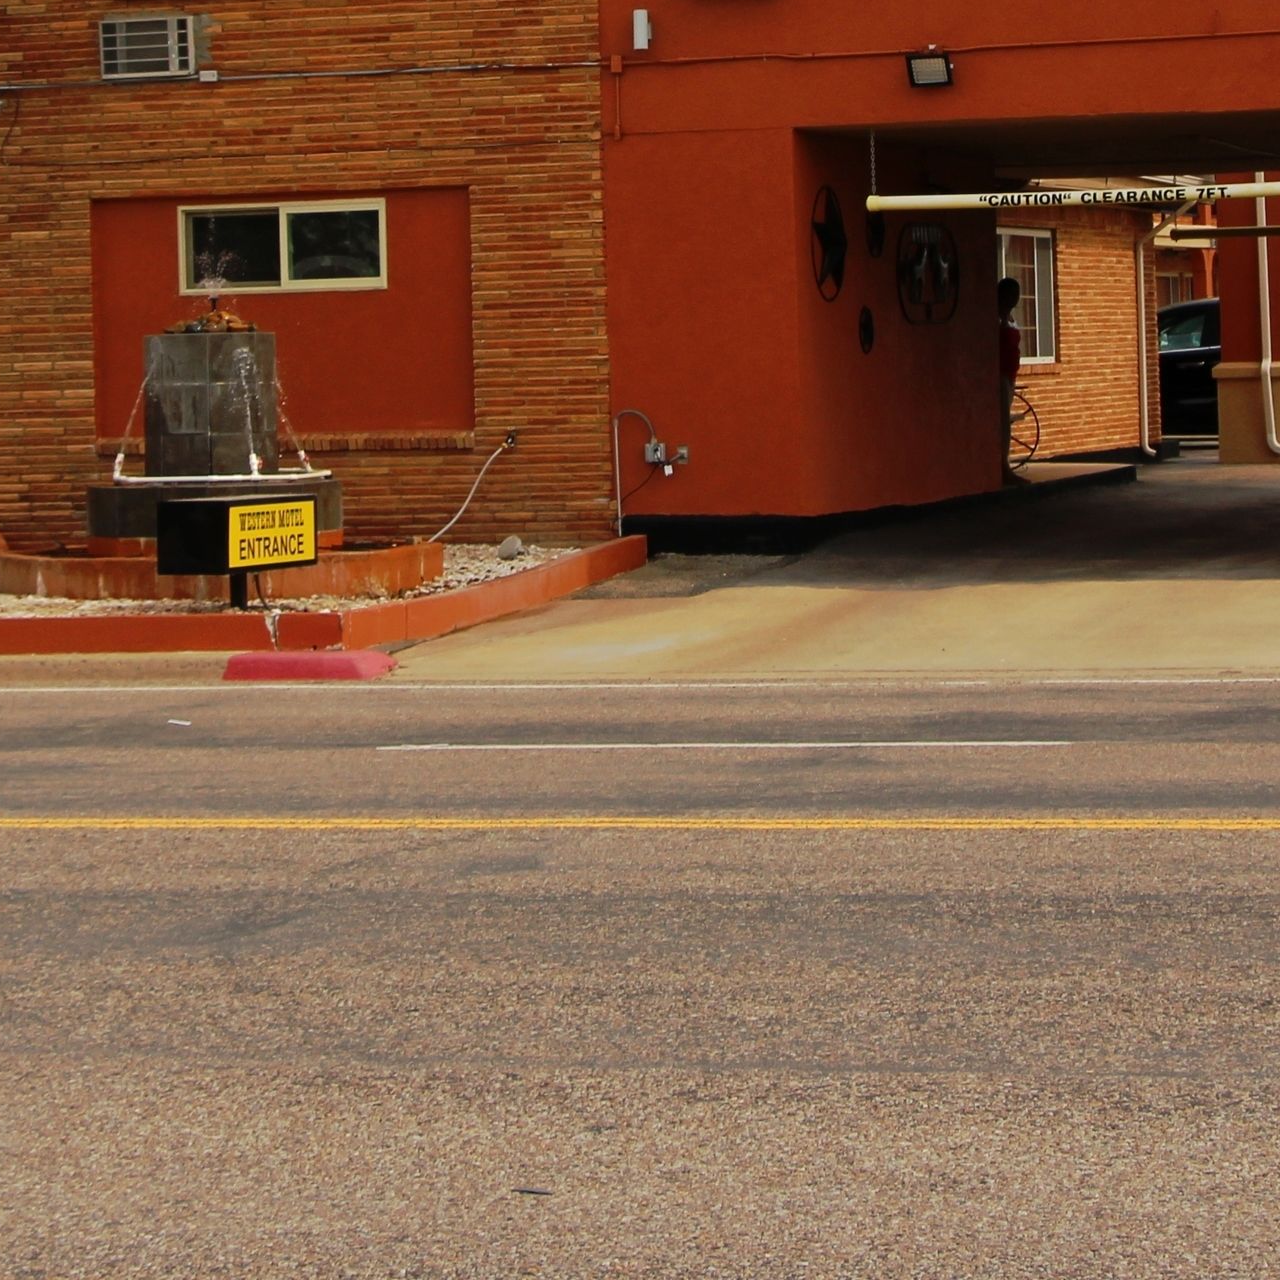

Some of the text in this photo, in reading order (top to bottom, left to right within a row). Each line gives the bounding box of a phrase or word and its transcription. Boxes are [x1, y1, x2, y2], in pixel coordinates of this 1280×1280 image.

[1080, 187, 1186, 204] CLEARANCE
[1196, 185, 1231, 201] 7FT.
[239, 507, 304, 532] WESTERN MOTEL
[239, 533, 304, 560] ENTRANCE
